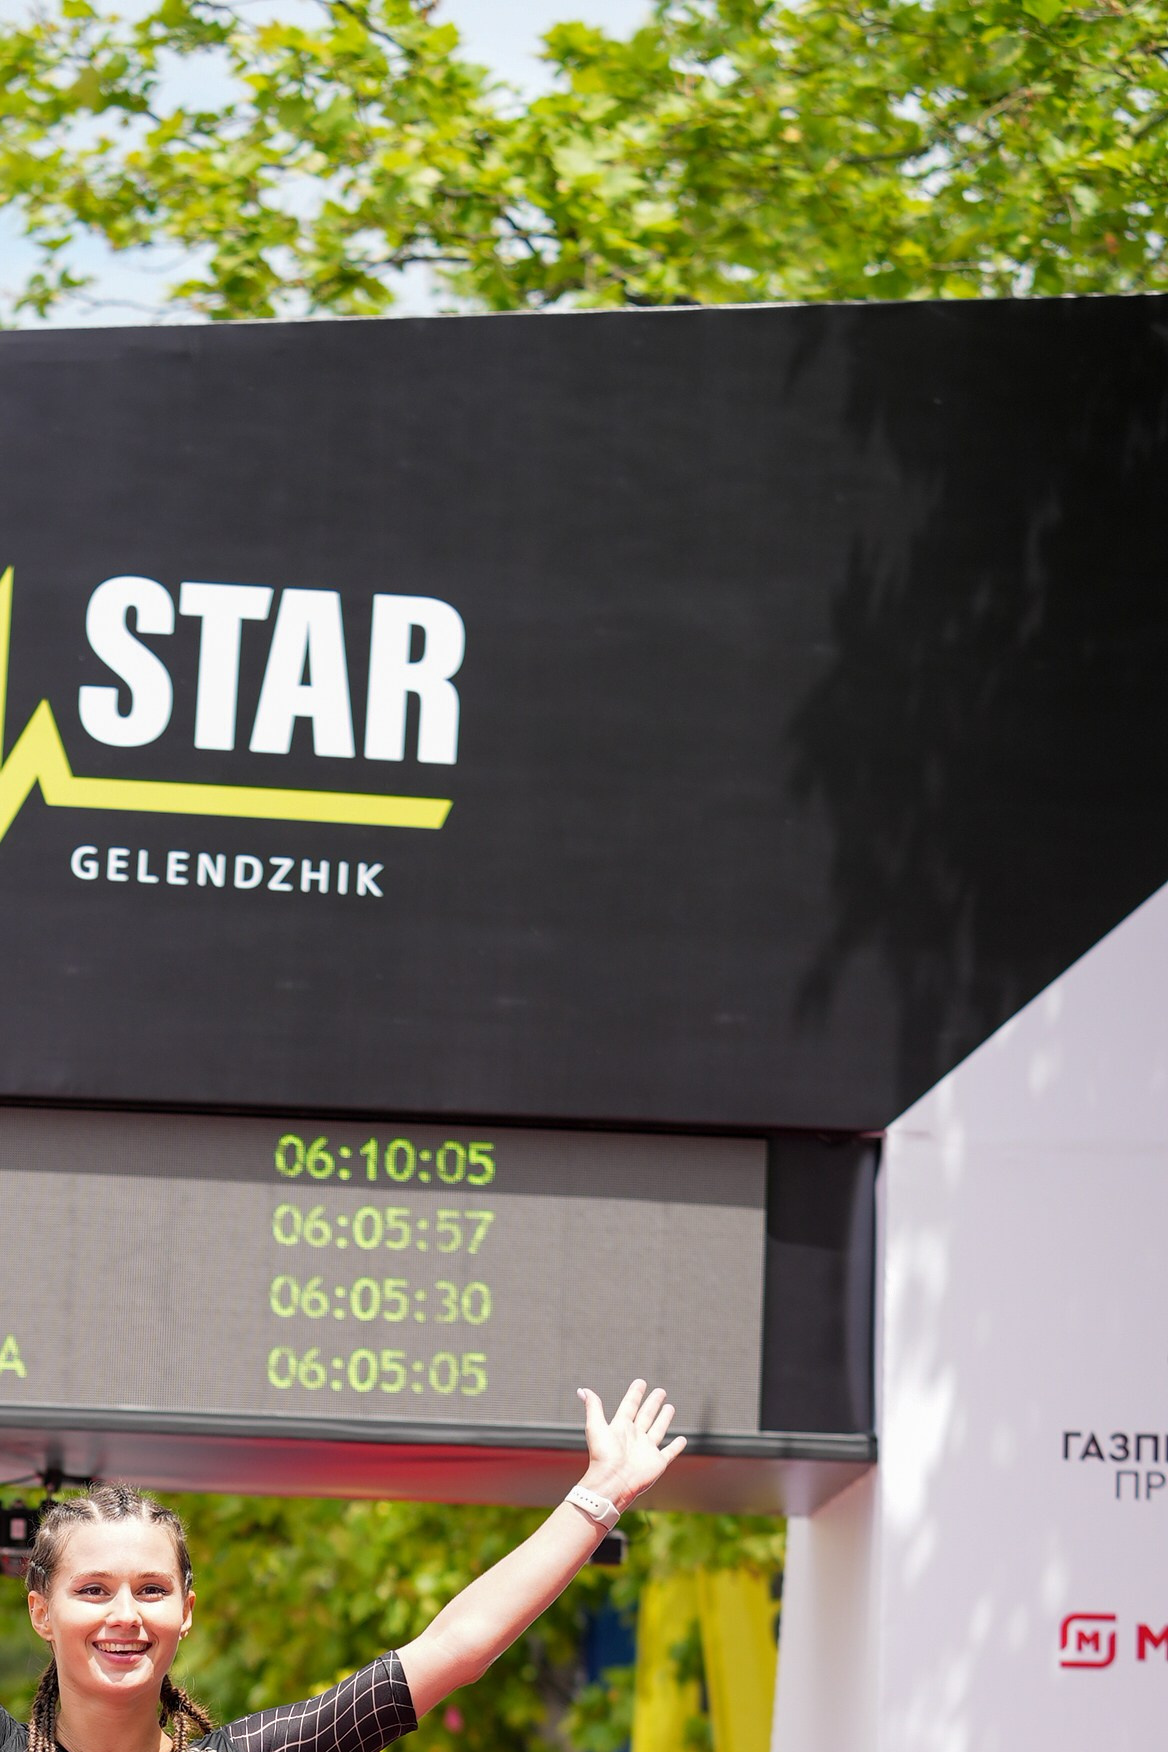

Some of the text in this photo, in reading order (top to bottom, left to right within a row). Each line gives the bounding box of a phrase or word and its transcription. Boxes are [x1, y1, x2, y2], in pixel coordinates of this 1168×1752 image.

[77, 575, 466, 765] STAR
[69, 845, 386, 899] GELENDZHIK
[274, 1133, 497, 1186] 06:10:05
[271, 1203, 496, 1255] 06:05:57
[268, 1274, 492, 1325] 06:05:30
[266, 1344, 489, 1396] 06:05:05
[1062, 1431, 1168, 1462] ГАЗП
